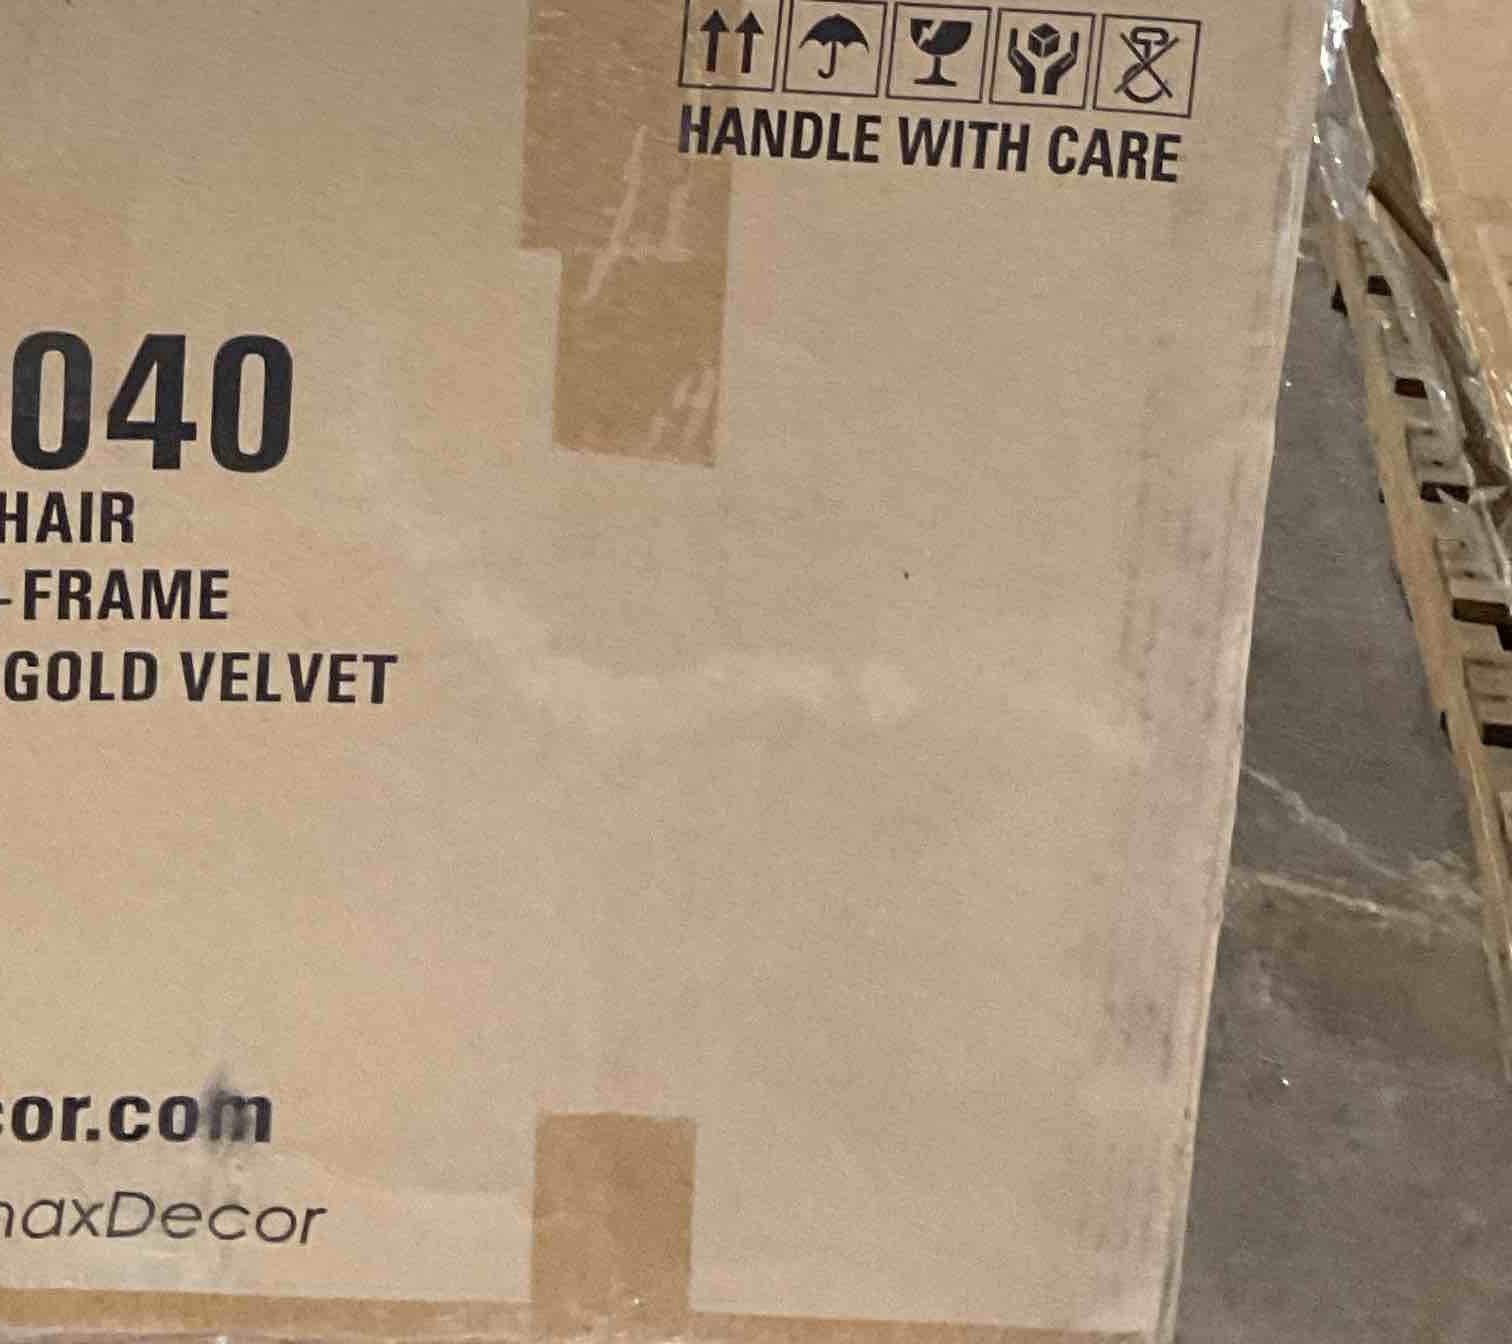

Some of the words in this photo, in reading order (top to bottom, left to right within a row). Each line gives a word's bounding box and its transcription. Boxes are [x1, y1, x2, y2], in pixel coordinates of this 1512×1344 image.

[678, 104, 882, 163] HANDLE
[898, 116, 1031, 172] WITH
[1048, 125, 1183, 183] CARE
[4, 650, 158, 703] GOLD
[180, 651, 398, 705] VELVET
